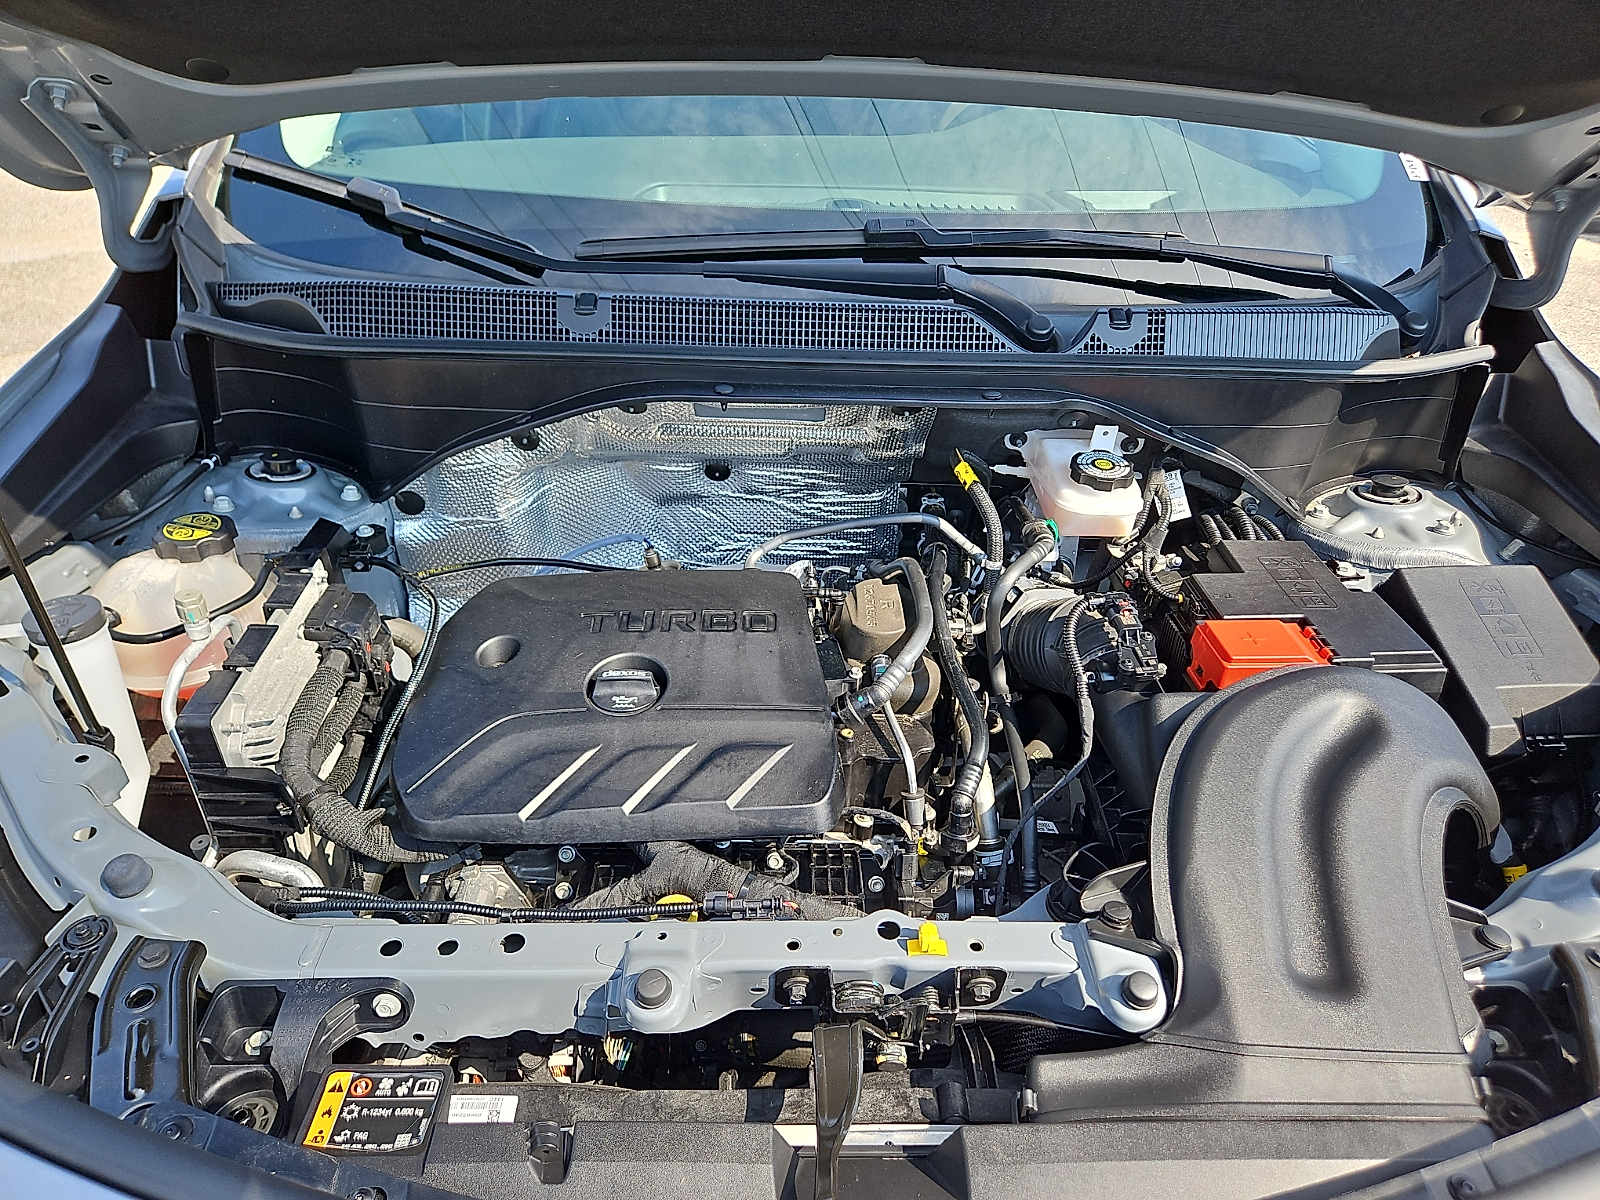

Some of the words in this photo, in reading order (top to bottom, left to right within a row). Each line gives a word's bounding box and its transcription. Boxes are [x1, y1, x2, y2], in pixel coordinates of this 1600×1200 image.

[880, 599, 895, 610] R
[580, 609, 777, 633] TURBO
[602, 668, 647, 678] dexos
[374, 1089, 392, 1097] AUTO
[361, 1107, 393, 1119] R-1234yf
[414, 1106, 424, 1119] kg
[353, 1131, 369, 1142] PAG
